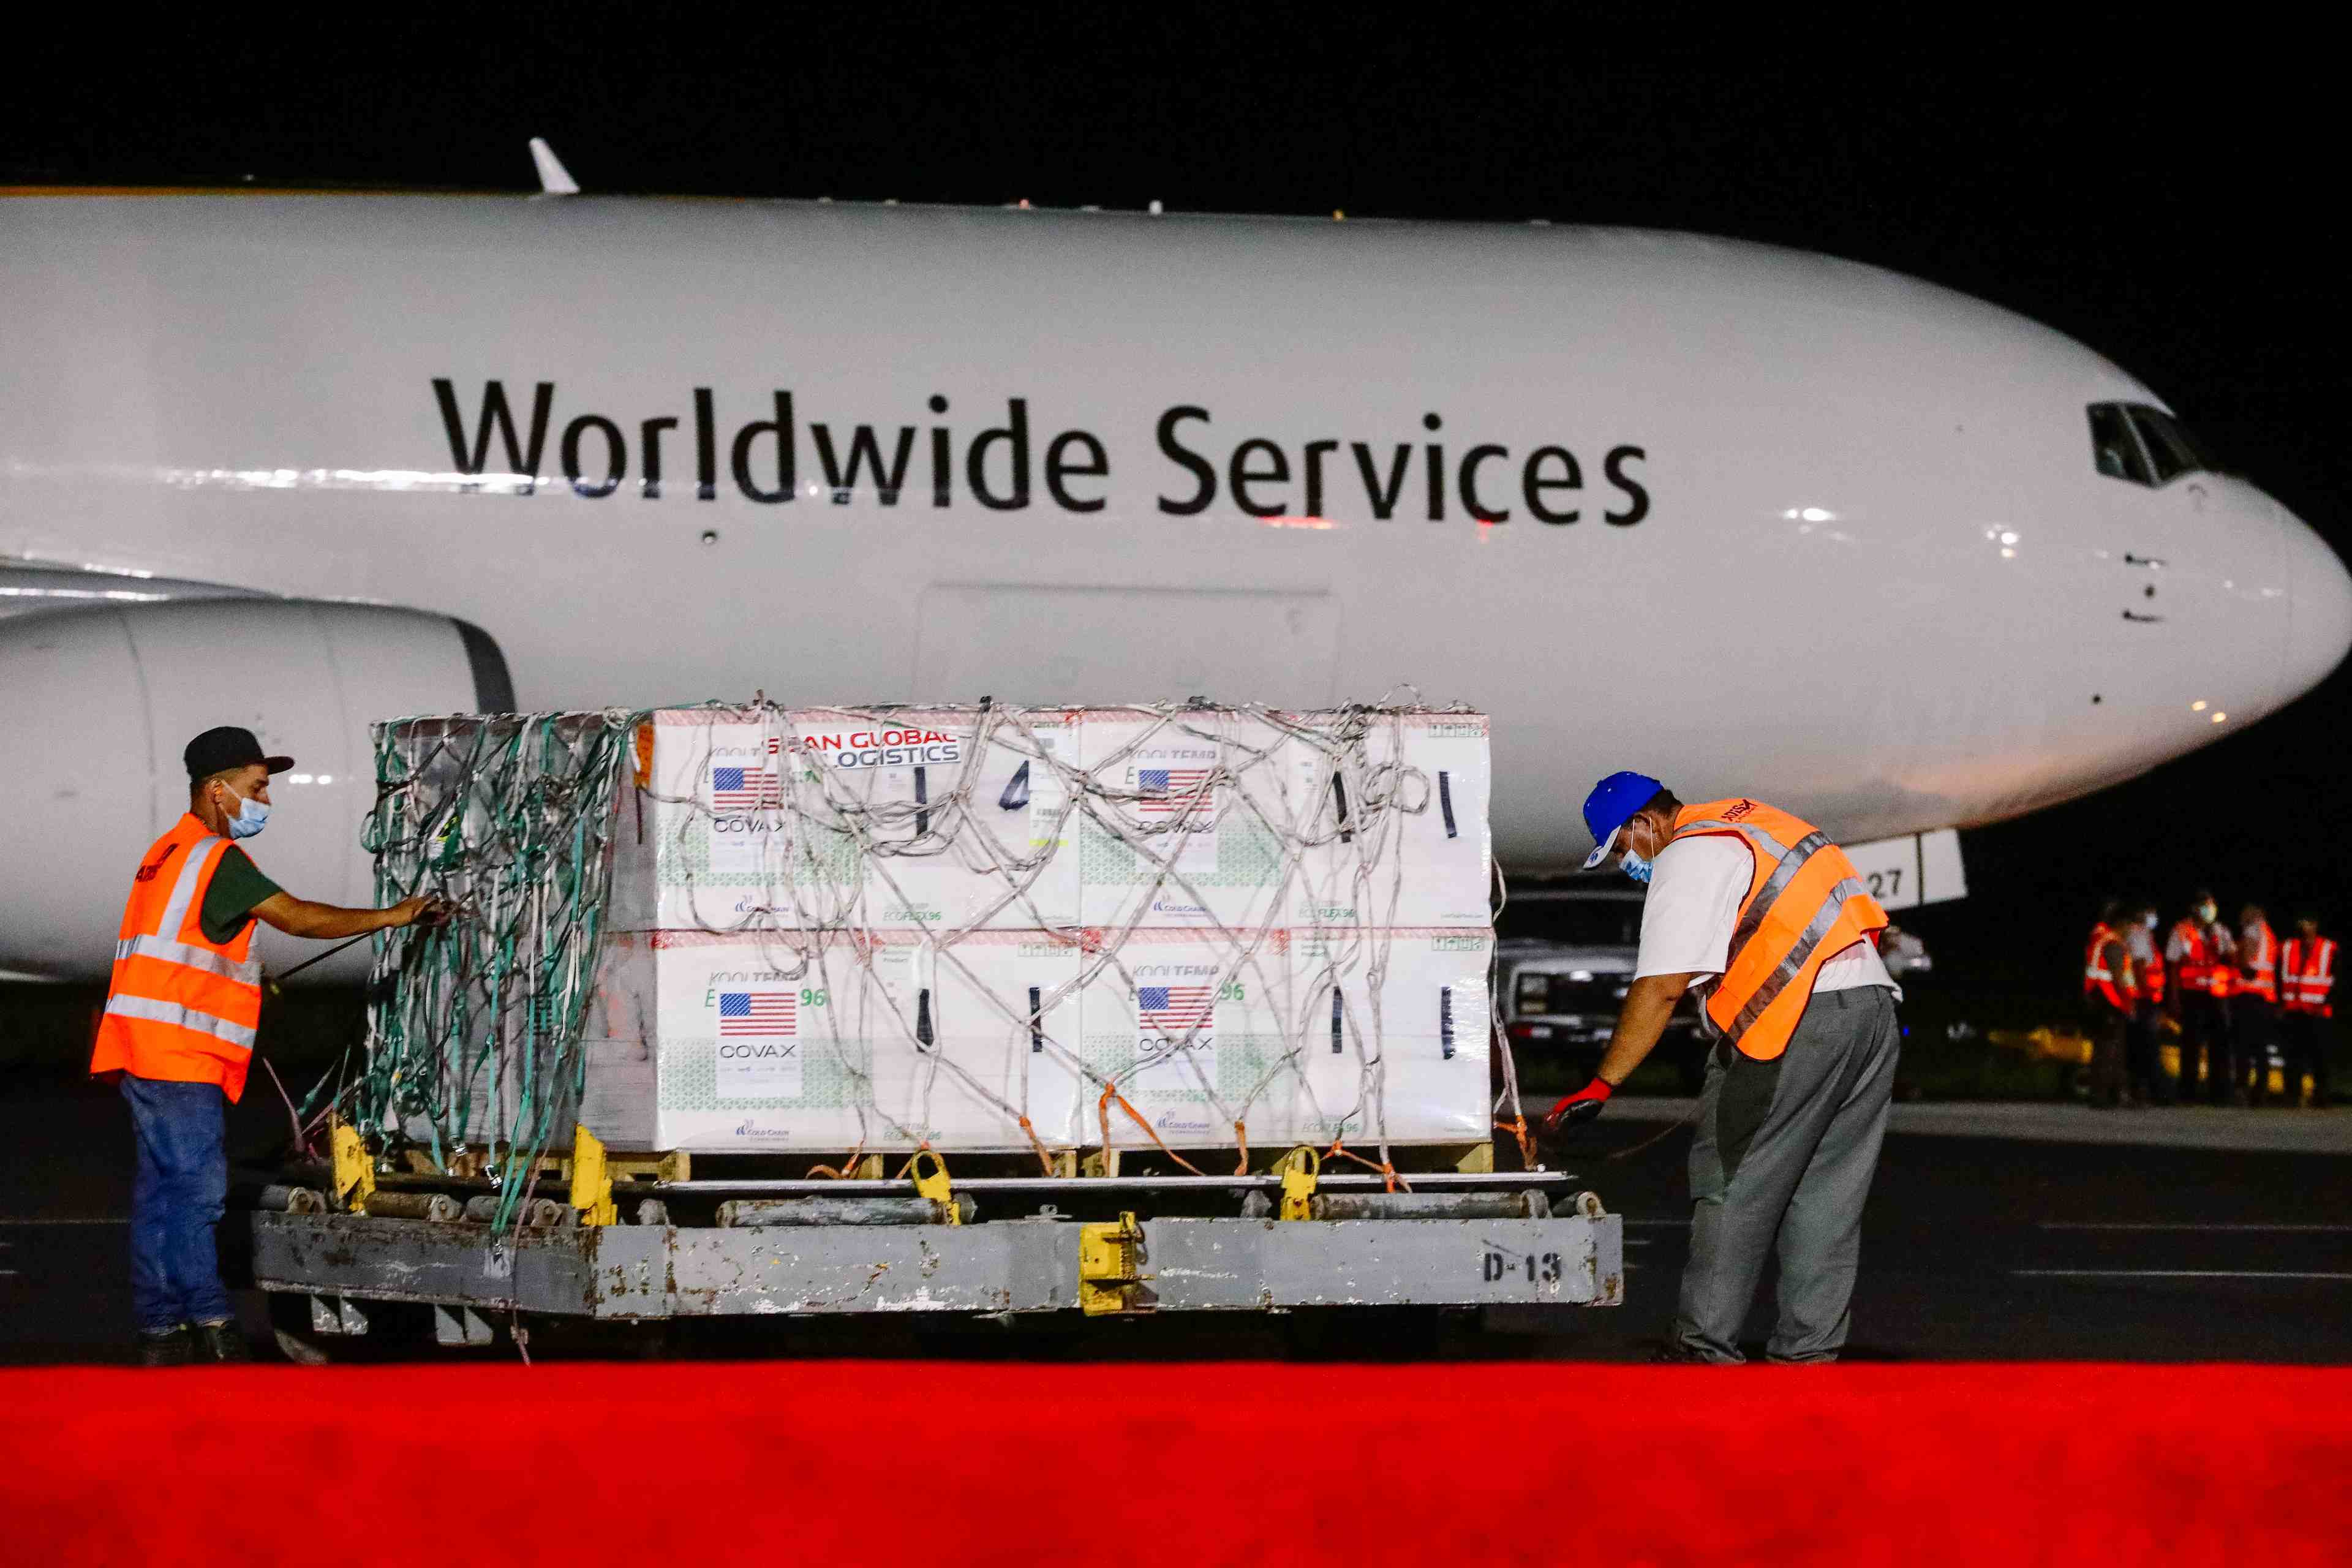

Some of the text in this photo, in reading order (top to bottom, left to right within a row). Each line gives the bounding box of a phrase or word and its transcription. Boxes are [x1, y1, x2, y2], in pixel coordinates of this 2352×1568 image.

[431, 377, 1650, 527] Worldwide Services
[766, 734, 842, 755] SAN
[831, 744, 959, 767] OGISTICS
[720, 1044, 796, 1058] COVAX
[1483, 1252, 1562, 1282] D-13
